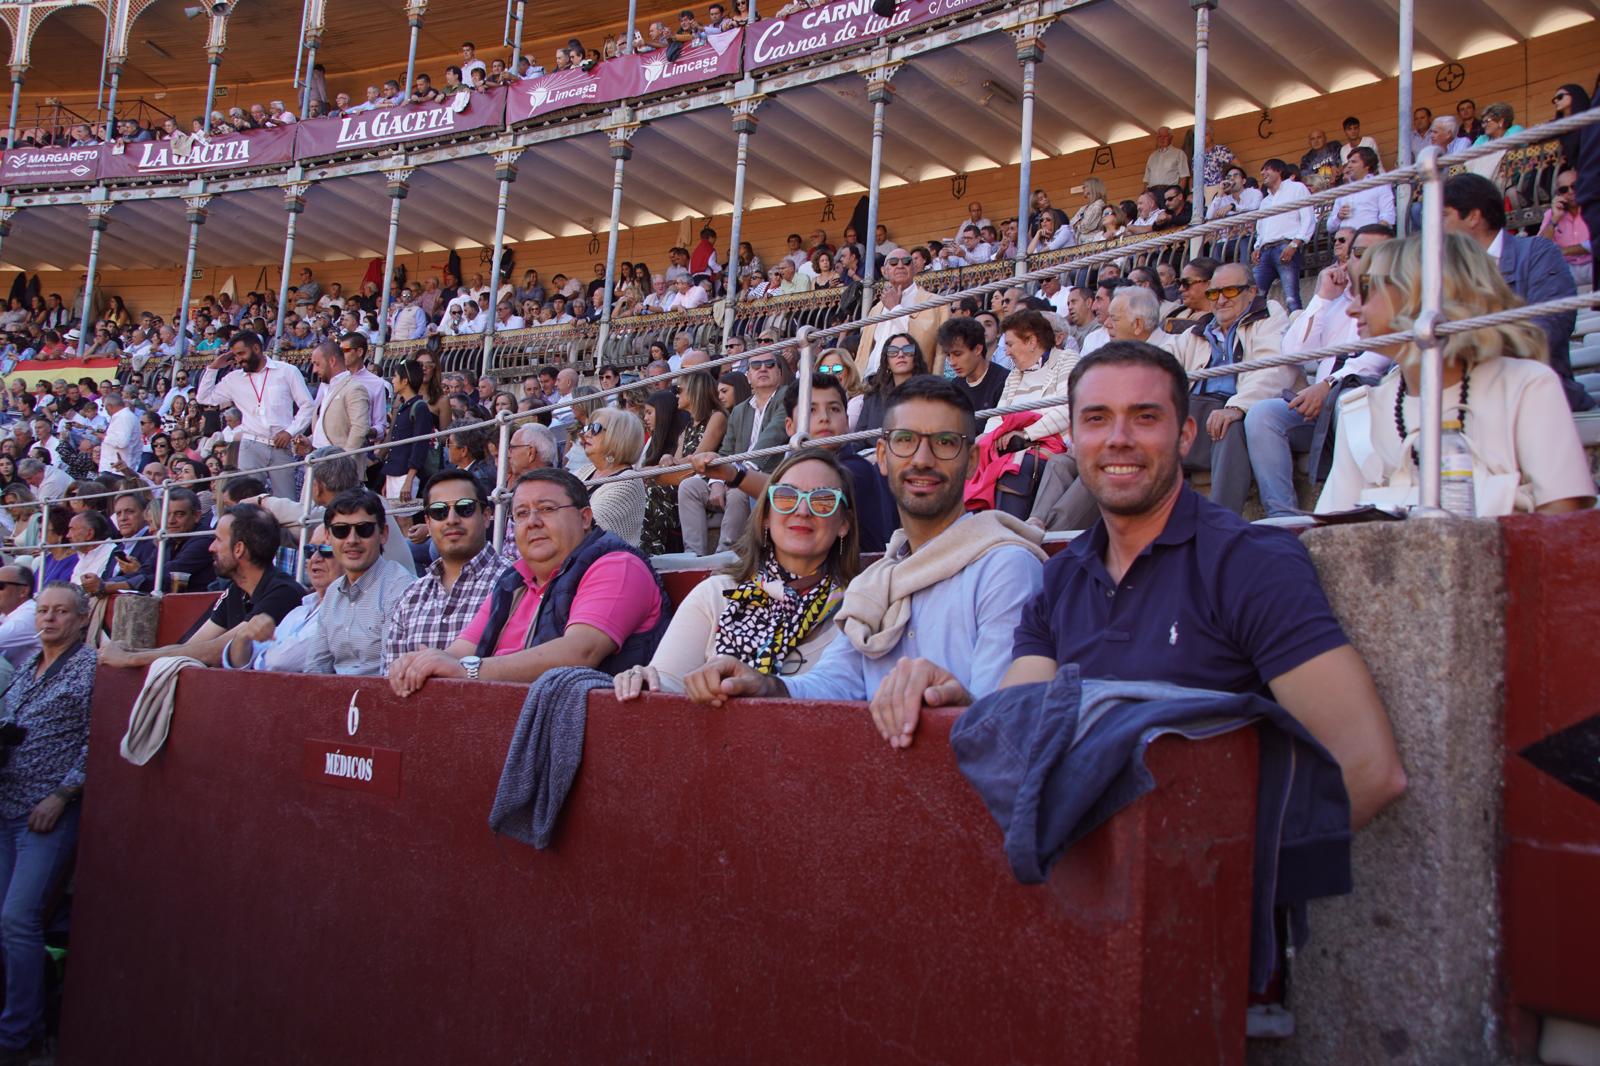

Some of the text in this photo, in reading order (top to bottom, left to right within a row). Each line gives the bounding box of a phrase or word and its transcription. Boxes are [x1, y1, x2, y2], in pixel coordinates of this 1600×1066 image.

[753, 21, 827, 63] Carnes
[832, 21, 857, 44] de
[662, 55, 718, 78] Limcasa
[546, 83, 598, 104] Limcasa
[336, 106, 455, 143] LA GACETA
[27, 150, 98, 163] MARGARETO
[138, 143, 169, 167] LA
[347, 688, 360, 736] 6
[324, 749, 373, 782] MÉDICOS
